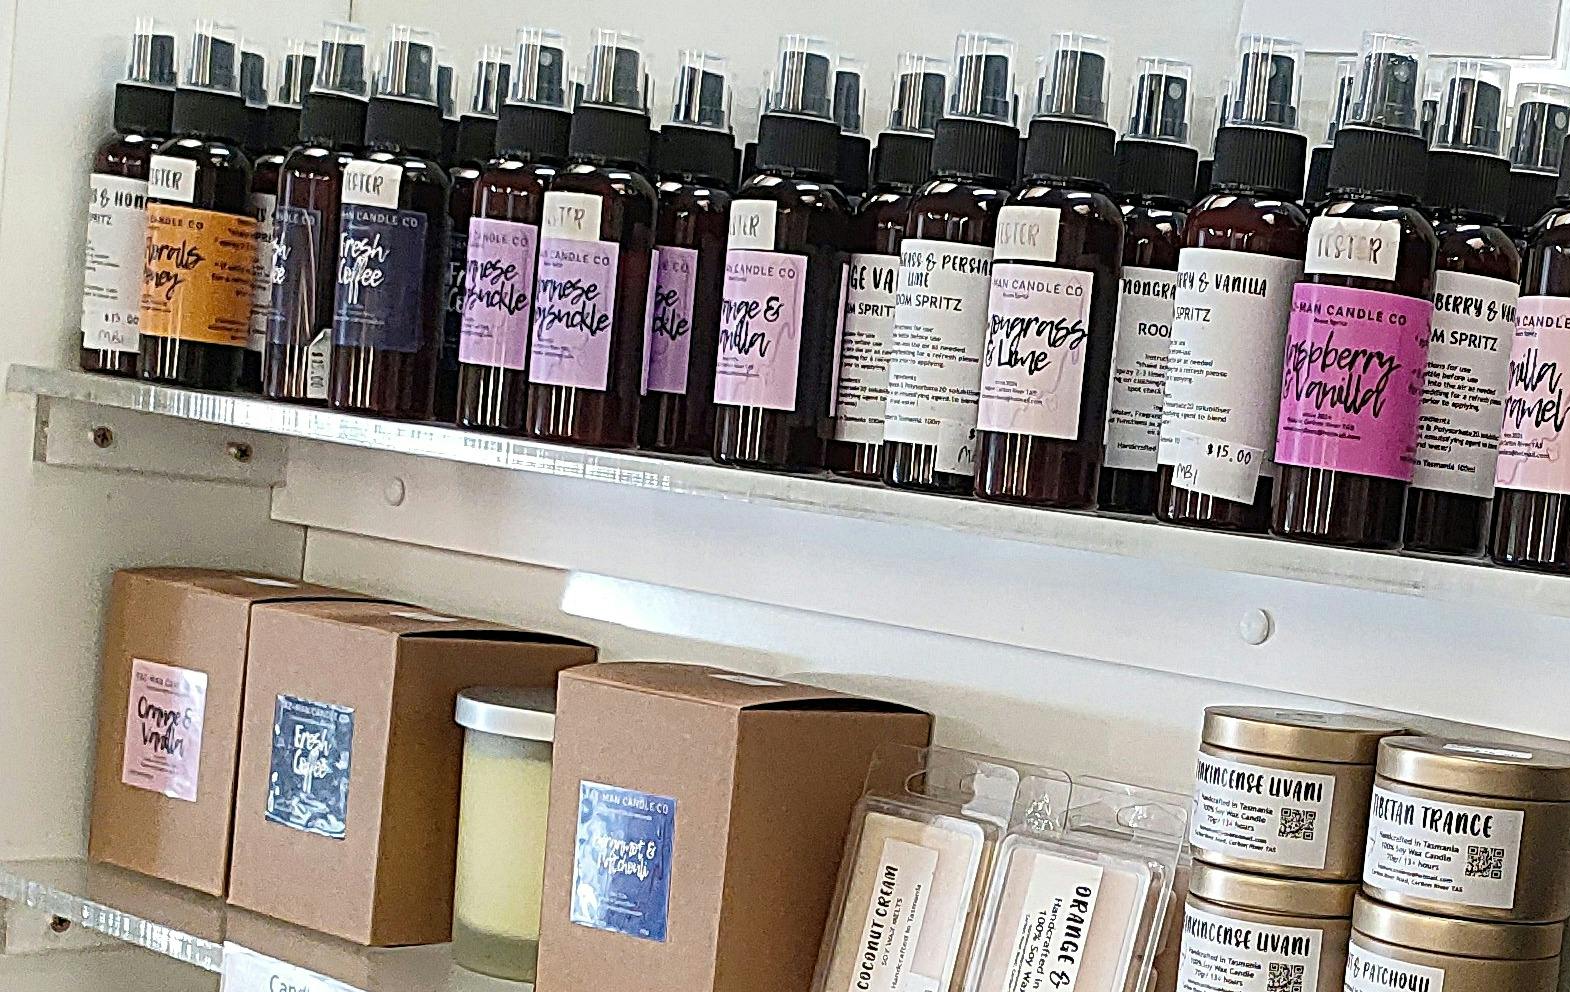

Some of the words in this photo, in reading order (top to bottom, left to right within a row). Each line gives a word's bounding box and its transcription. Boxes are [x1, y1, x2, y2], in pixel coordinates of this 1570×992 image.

[779, 266, 796, 279] CO
[1011, 278, 1060, 295] CANDLE
[1066, 284, 1083, 297] CO
[1214, 273, 1267, 298] VANILLA
[915, 295, 963, 312] SPRITZ
[1326, 305, 1384, 323] CANDLE
[1389, 312, 1407, 326] CO
[1449, 330, 1498, 352] SPRITZ
[1294, 364, 1389, 419] Vanilla
[1207, 443, 1251, 464] $15.00
[656, 803, 669, 815] CO
[1421, 805, 1494, 839] TRANCE
[909, 883, 922, 921] Tasmania
[856, 914, 886, 991] COCONUT
[876, 864, 898, 919] CREAM
[1041, 897, 1063, 975] Handcrafted
[1059, 885, 1092, 965] ORANGE
[1024, 944, 1039, 968] Soy
[1037, 974, 1045, 985] in
[1048, 968, 1070, 990] &
